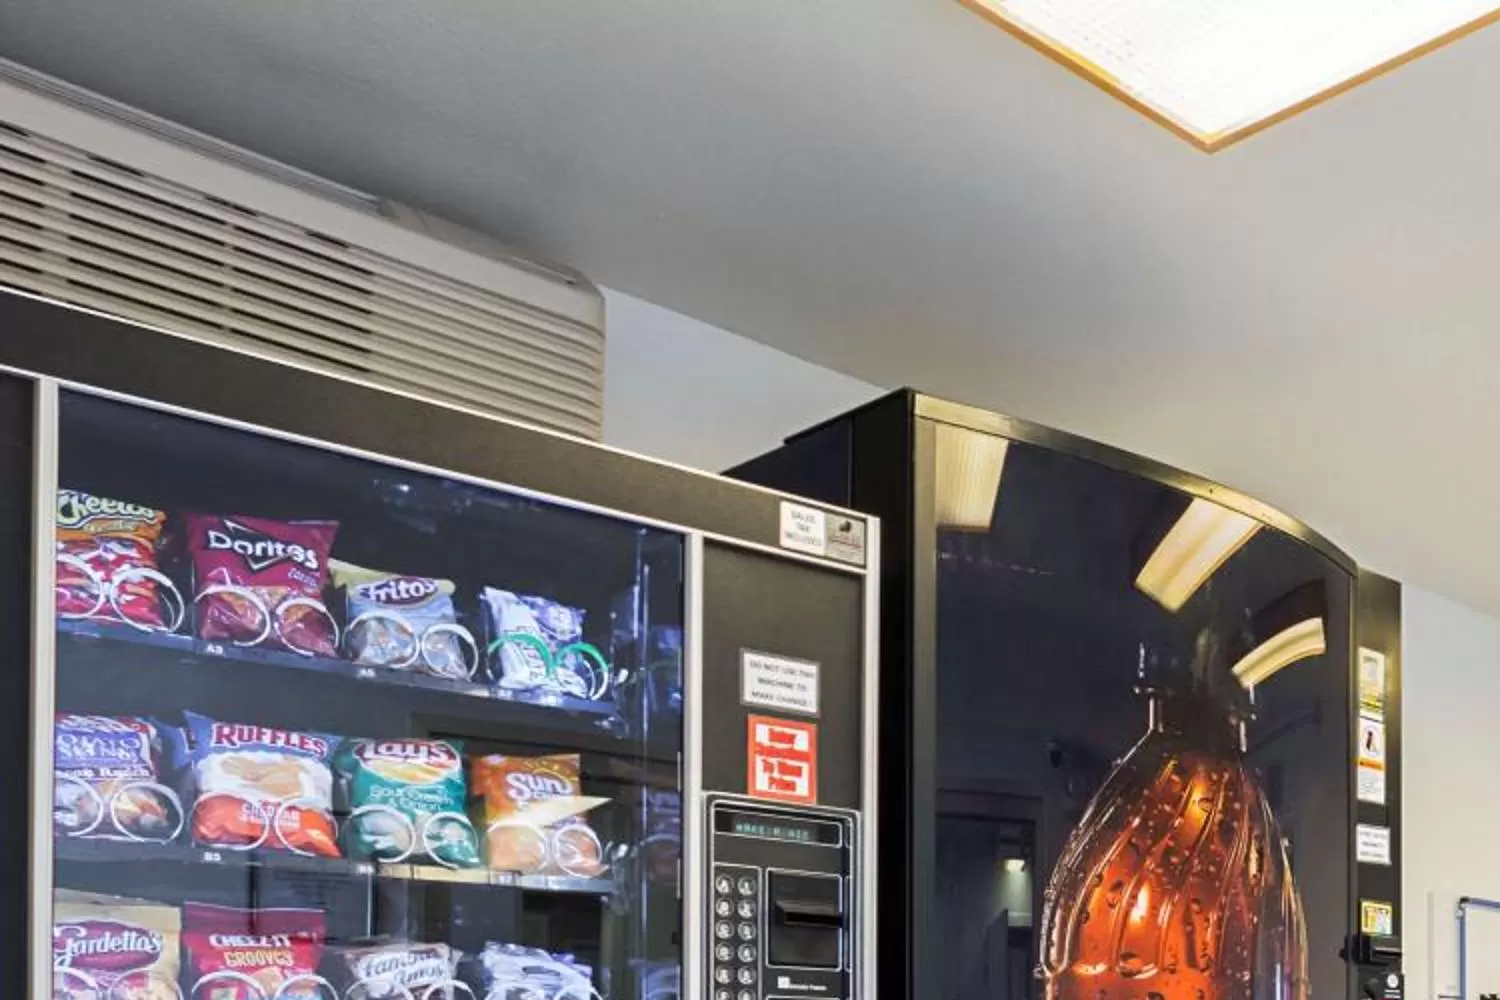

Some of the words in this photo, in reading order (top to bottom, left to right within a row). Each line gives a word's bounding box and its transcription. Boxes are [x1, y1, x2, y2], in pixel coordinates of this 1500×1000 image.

[57, 489, 155, 525] Cheetos
[208, 530, 319, 570] Doritos
[369, 577, 438, 602] Fritos
[213, 722, 329, 757] RUFFLES
[506, 772, 572, 801] Sun
